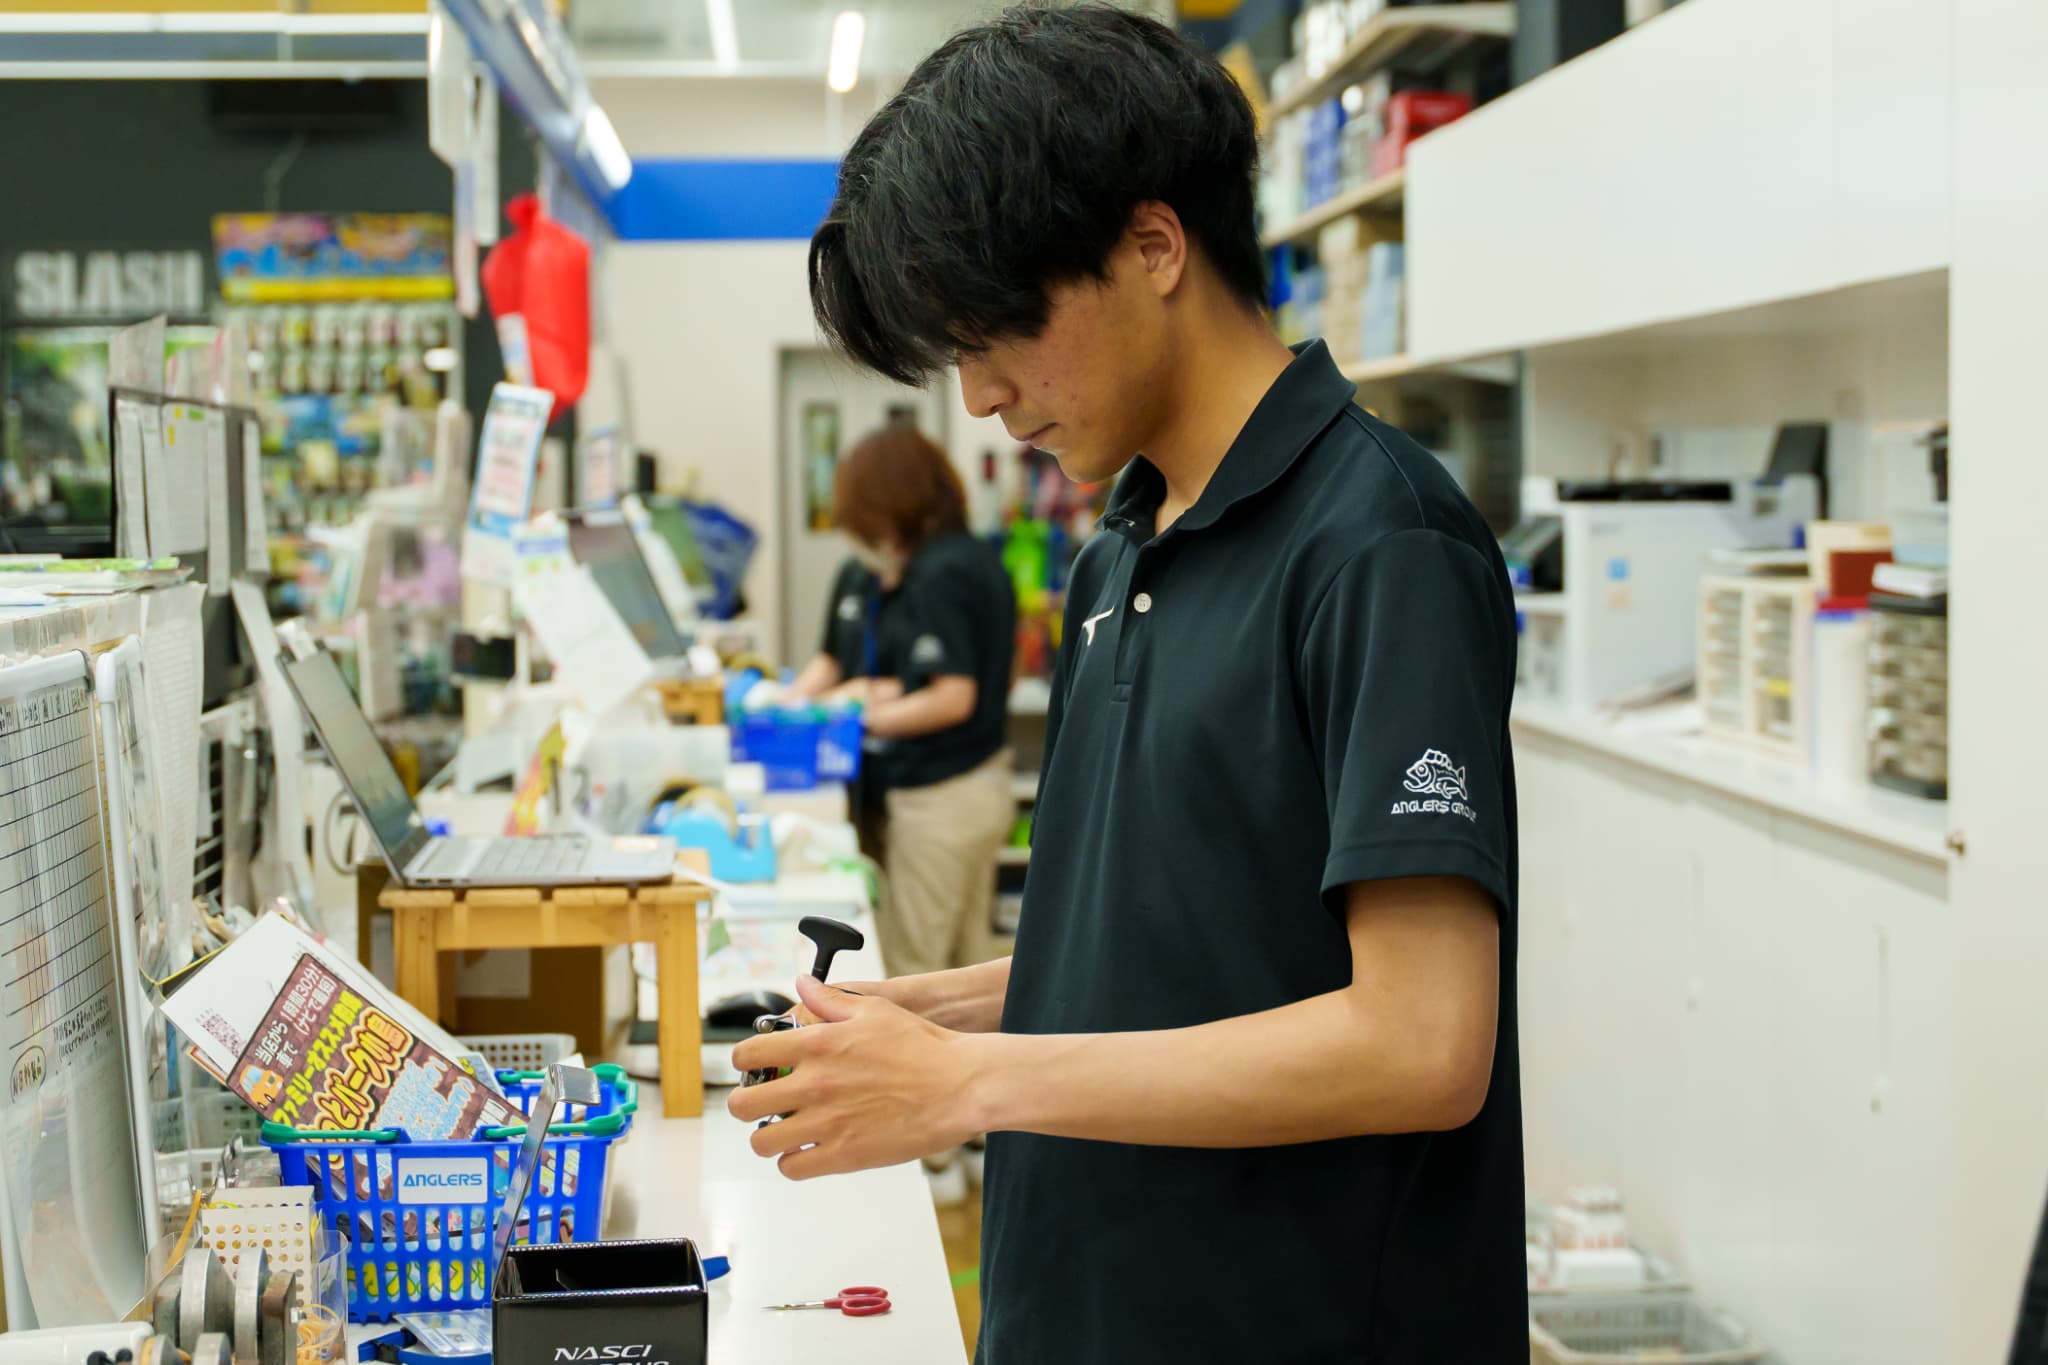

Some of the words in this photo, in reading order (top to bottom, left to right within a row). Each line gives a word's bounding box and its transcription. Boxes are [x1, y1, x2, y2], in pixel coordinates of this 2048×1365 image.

[1391, 799, 1450, 814] ANGLERS
[403, 1173, 483, 1187] ANGLERS
[554, 1344, 653, 1361] NASCI
